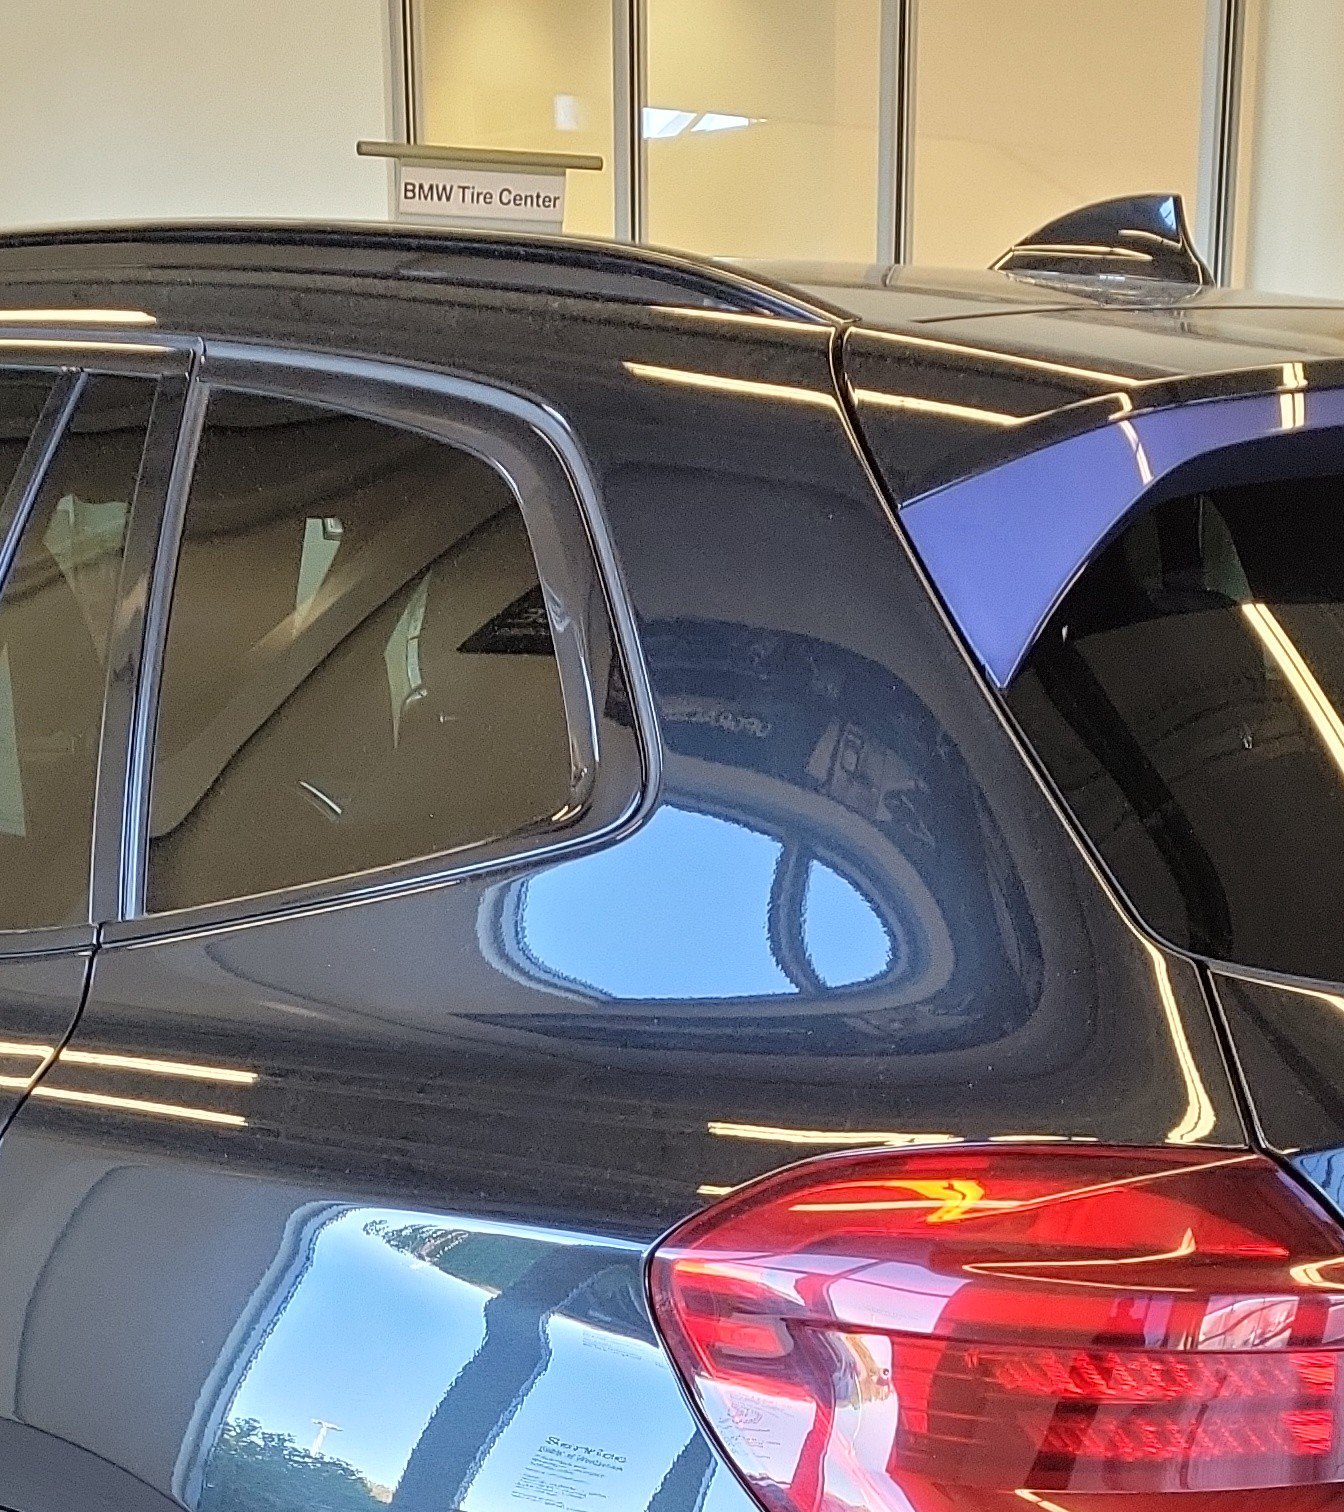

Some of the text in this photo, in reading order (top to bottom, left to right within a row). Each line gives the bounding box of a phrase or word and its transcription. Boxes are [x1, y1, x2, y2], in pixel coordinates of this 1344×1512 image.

[403, 181, 560, 209] BMW Tire Center
